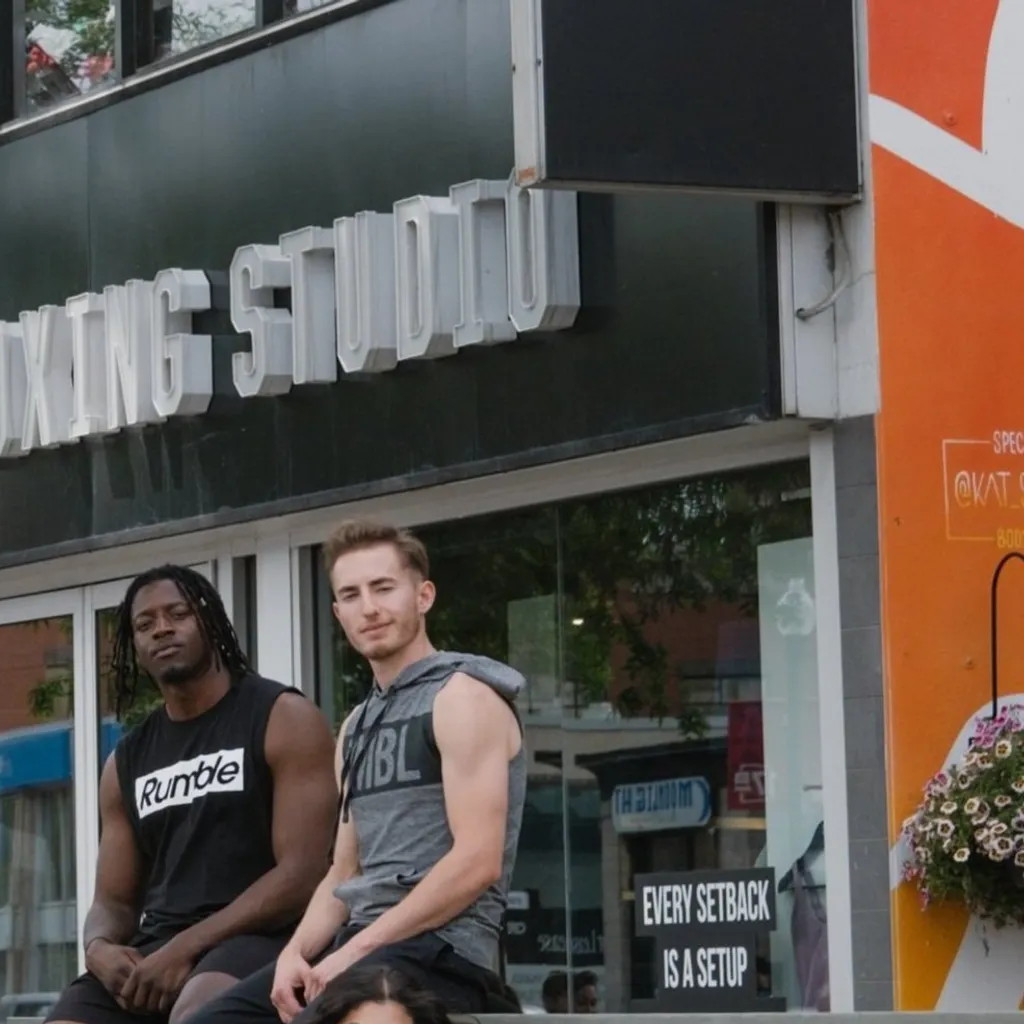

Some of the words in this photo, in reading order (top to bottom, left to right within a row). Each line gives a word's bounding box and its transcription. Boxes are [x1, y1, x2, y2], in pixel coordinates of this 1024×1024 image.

[229, 167, 581, 398] STUDIO
[140, 755, 240, 811] Rumble
[642, 883, 693, 926] EVERY
[696, 879, 771, 923] SETBACK
[663, 948, 680, 989] IS
[682, 948, 695, 988] A
[696, 946, 748, 988] SETUP
